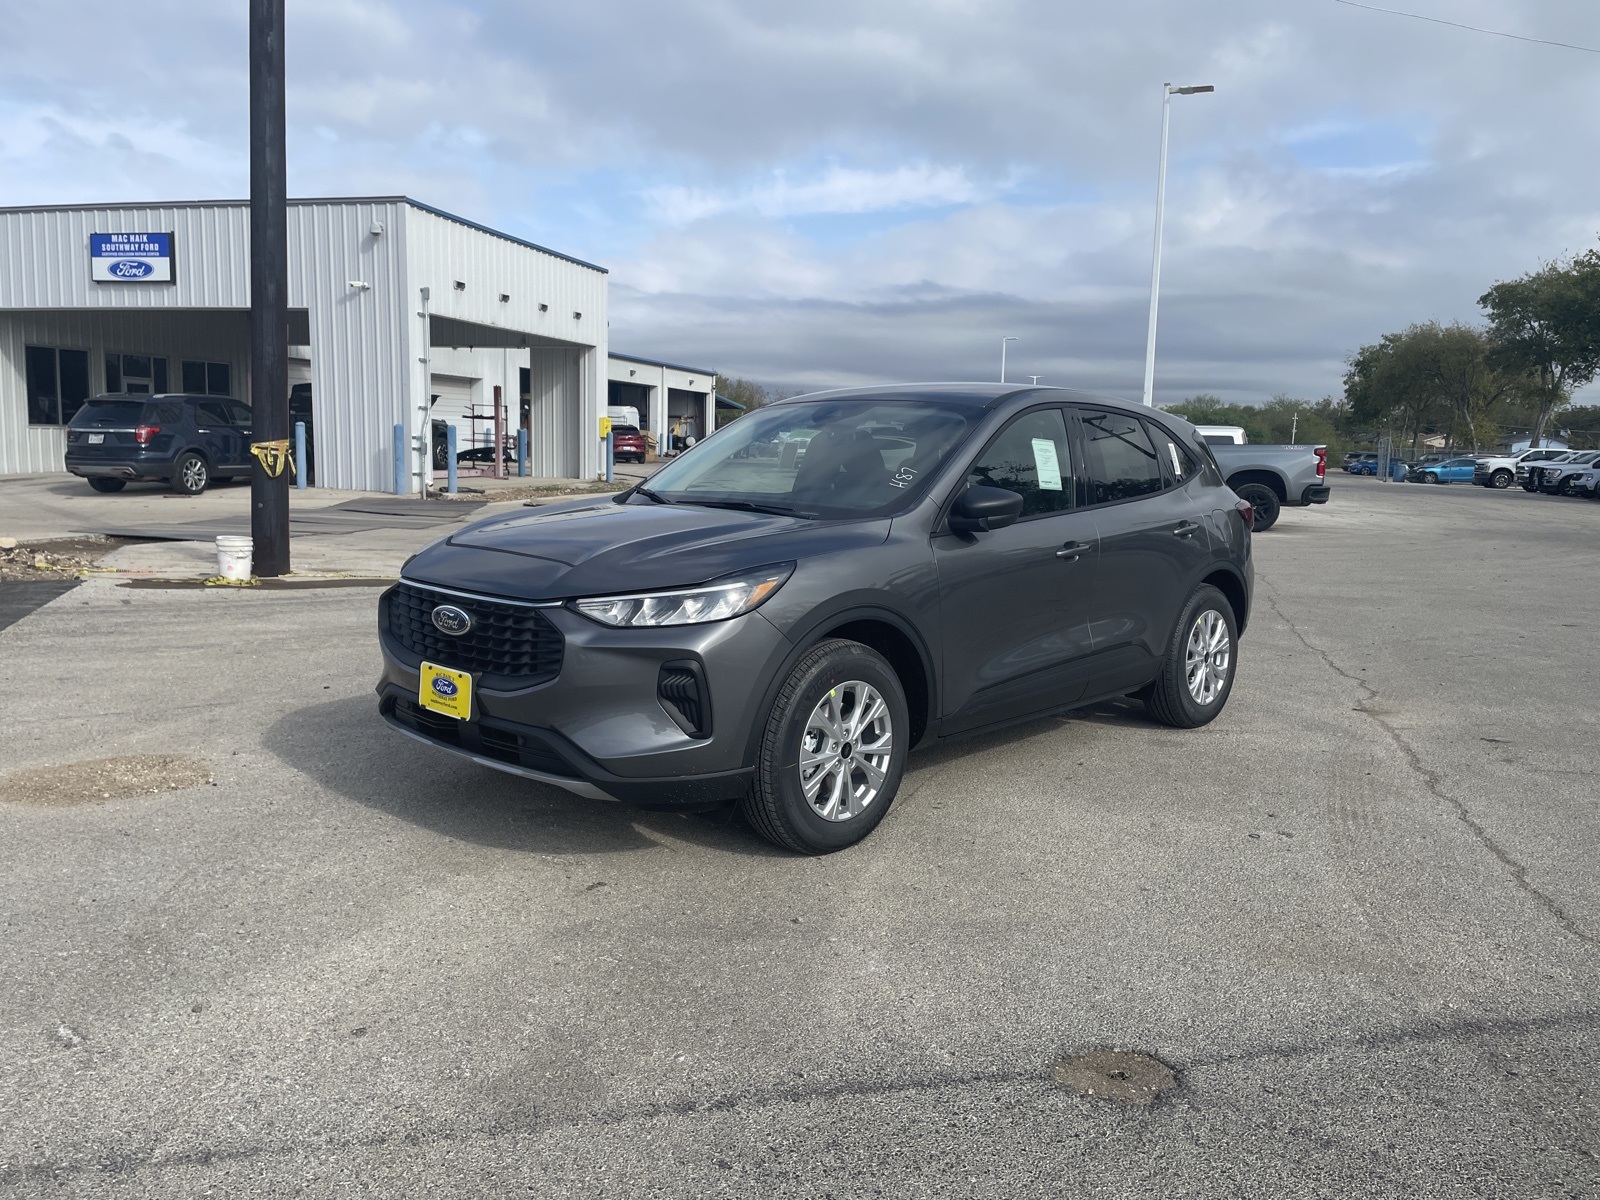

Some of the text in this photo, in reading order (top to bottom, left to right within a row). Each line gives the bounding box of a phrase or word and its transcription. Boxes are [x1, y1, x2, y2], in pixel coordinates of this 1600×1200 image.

[111, 234, 148, 243] MAC HAIK
[101, 243, 159, 251] SOUTHWAY FORD
[116, 261, 145, 277] Ford
[438, 610, 460, 630] Ford
[435, 678, 453, 694] Ford
